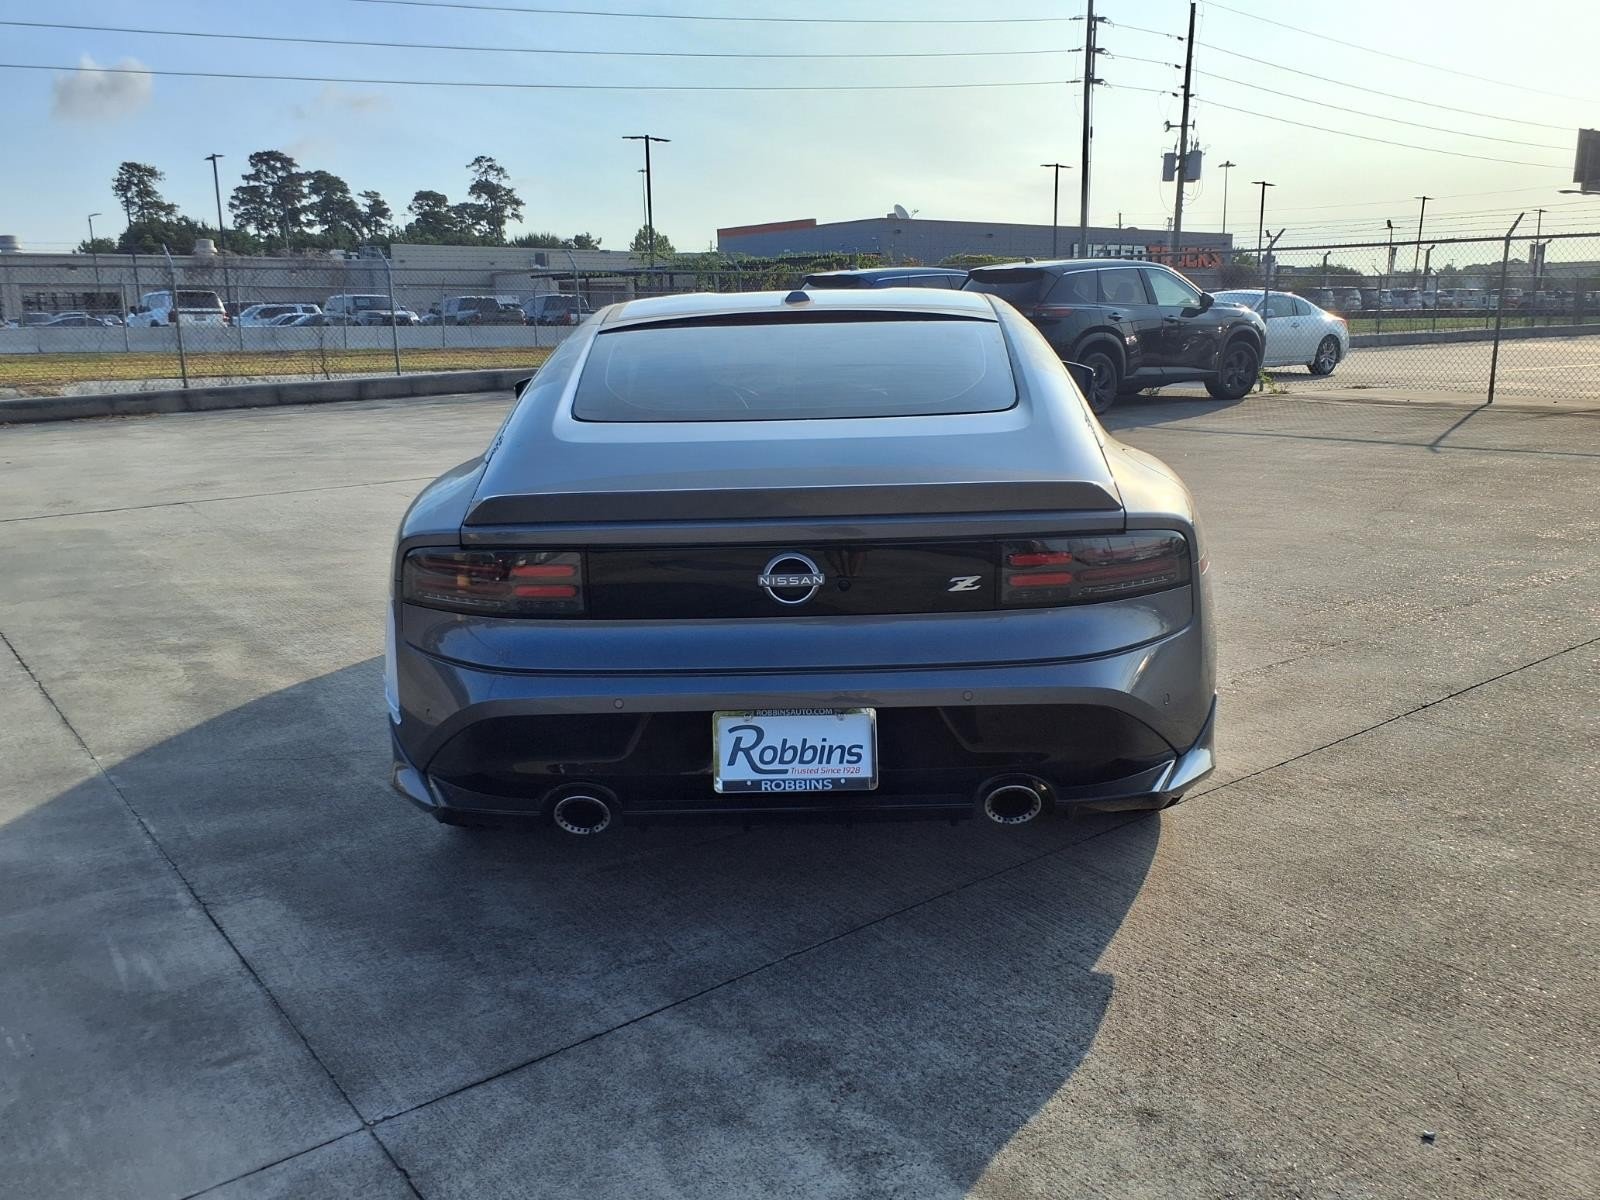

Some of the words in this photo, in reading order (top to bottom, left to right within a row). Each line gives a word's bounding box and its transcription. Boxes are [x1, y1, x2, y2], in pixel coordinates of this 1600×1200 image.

[758, 574, 824, 586] NISSAN
[947, 575, 982, 592] Z
[756, 708, 833, 716] ROBBINSAUTO.COM
[727, 724, 863, 775] Robbins
[791, 767, 819, 775] Trusted
[820, 767, 841, 775] Since
[842, 766, 861, 775] 1928
[761, 778, 833, 792] ROBBINS
